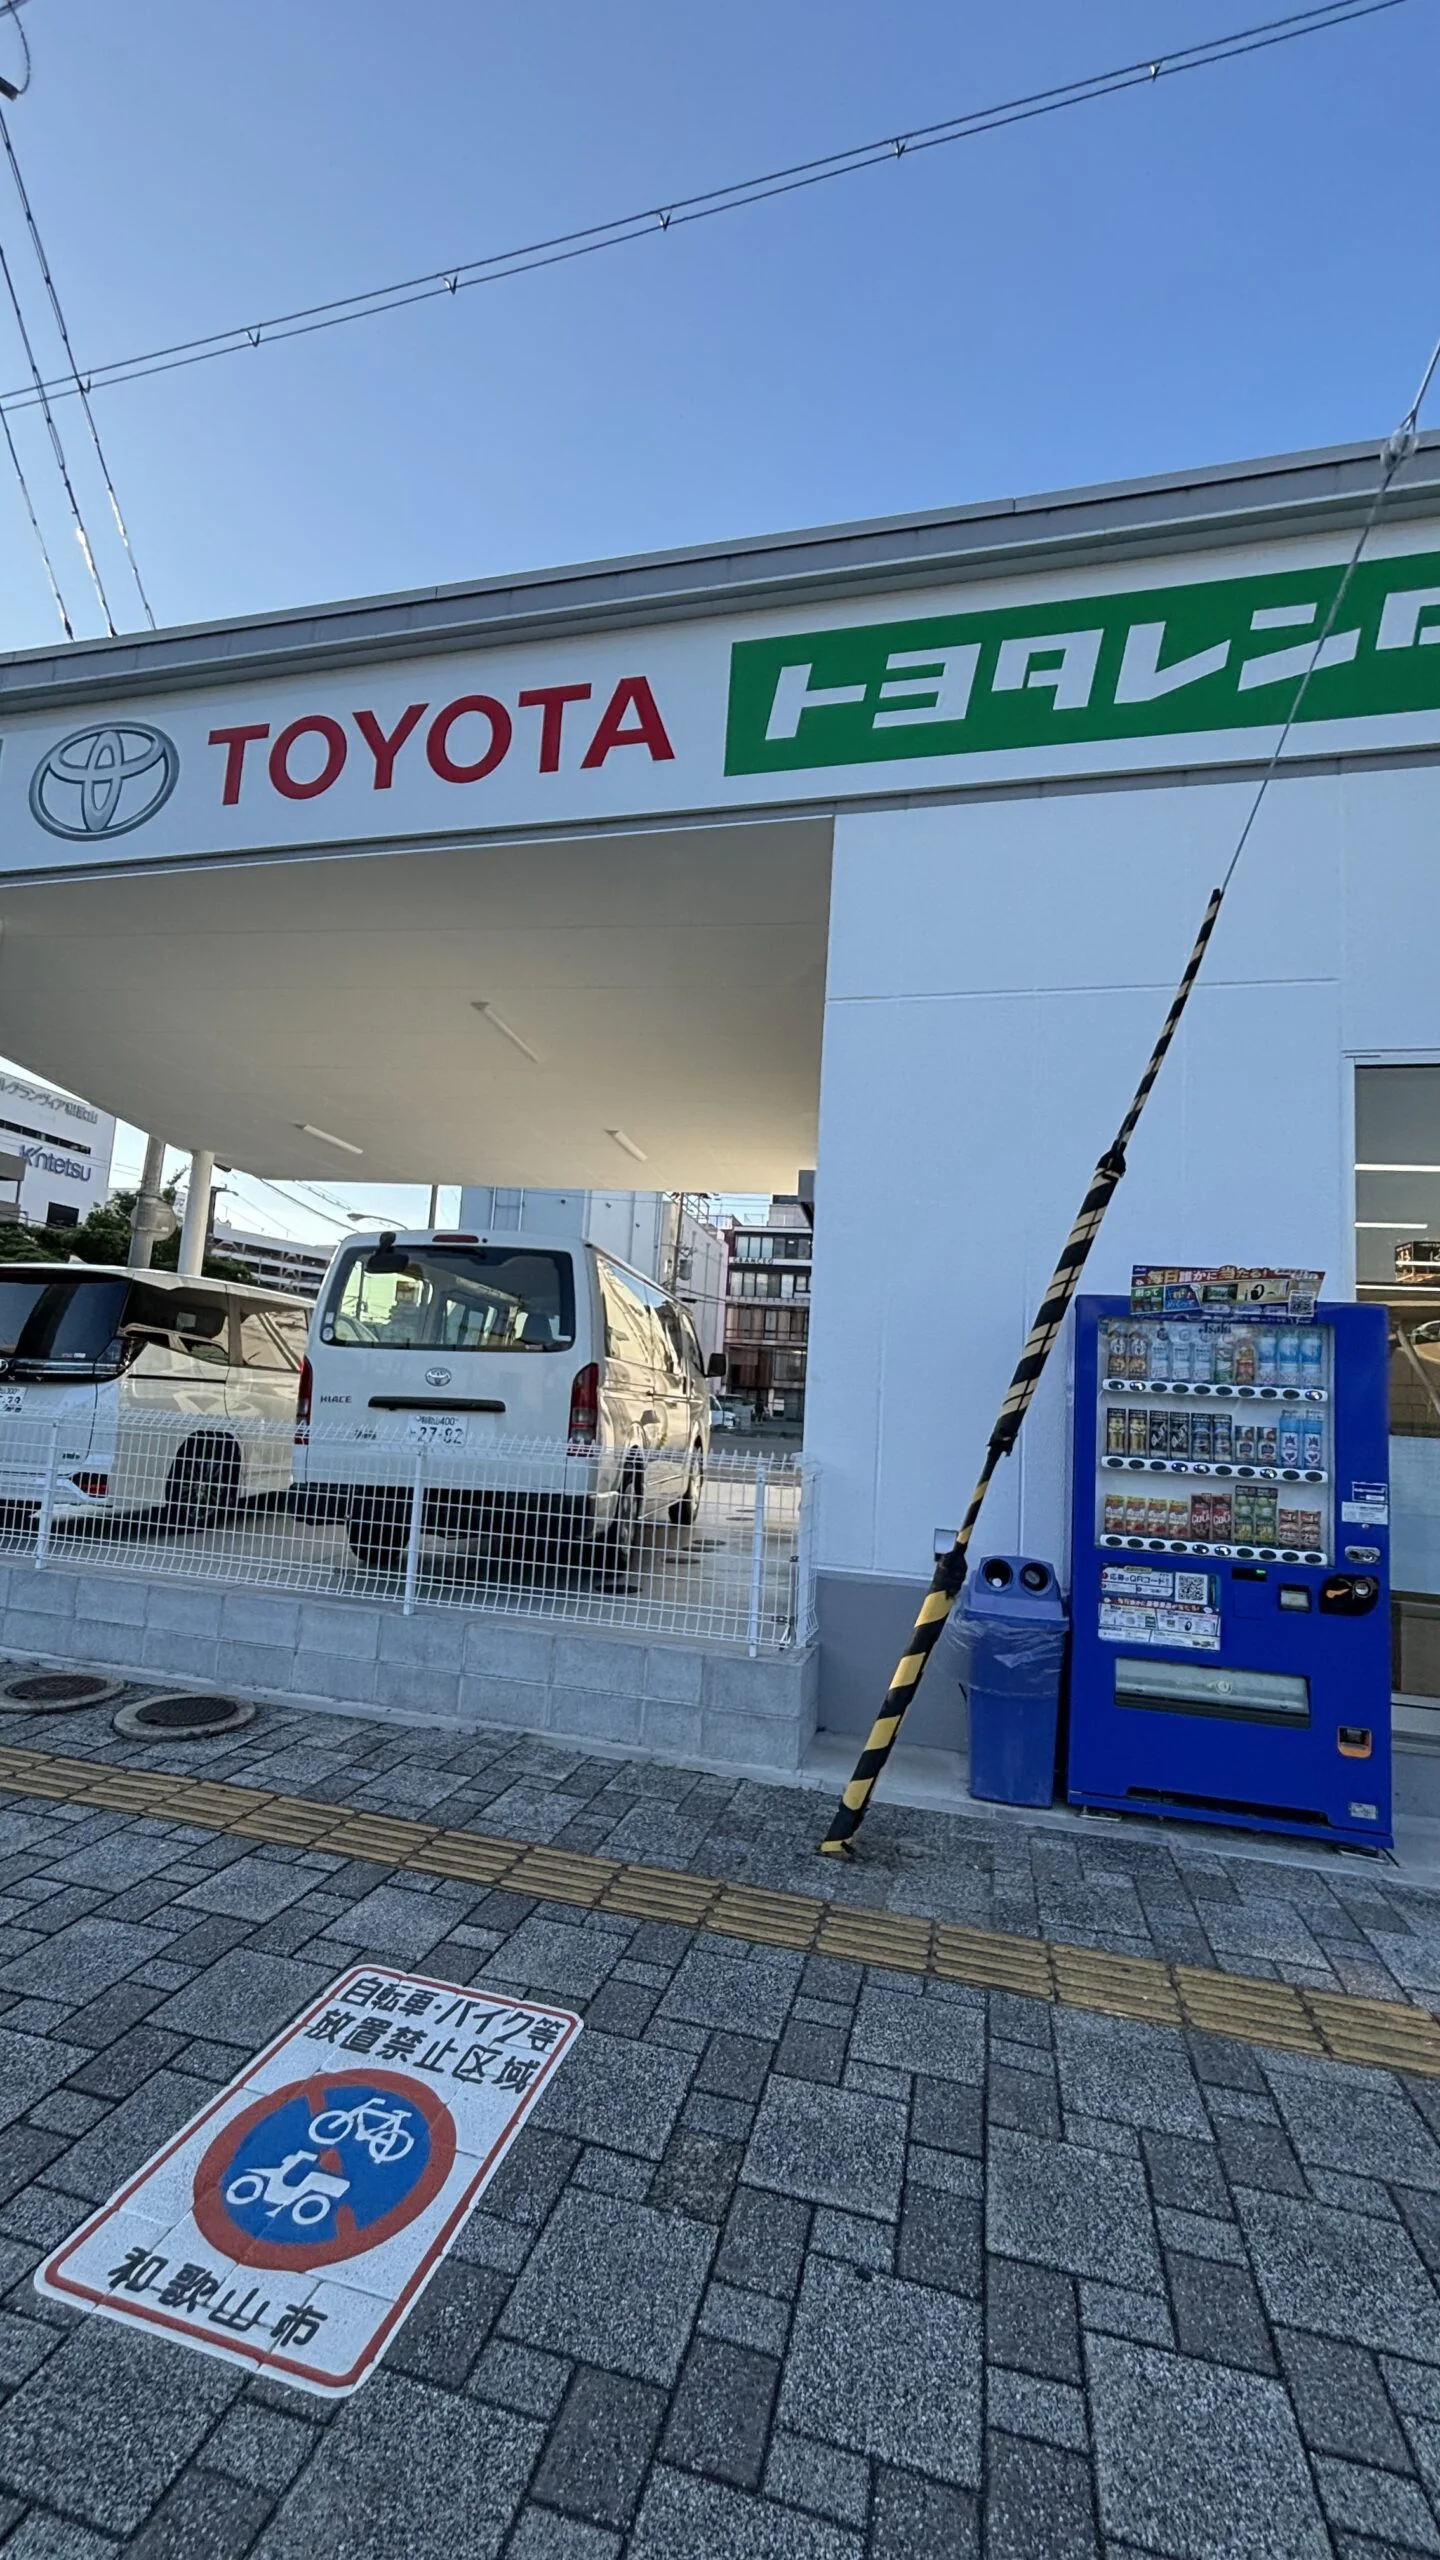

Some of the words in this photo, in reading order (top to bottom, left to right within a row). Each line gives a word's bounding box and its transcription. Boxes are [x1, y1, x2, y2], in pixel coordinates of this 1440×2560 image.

[208, 675, 675, 806] TOYOTA
[320, 1395, 352, 1404] HIACE
[304, 2008, 541, 2095] 放置禁止区域
[343, 1976, 566, 2052] 自転車・バイク等
[107, 2246, 329, 2347] 和歌山市
